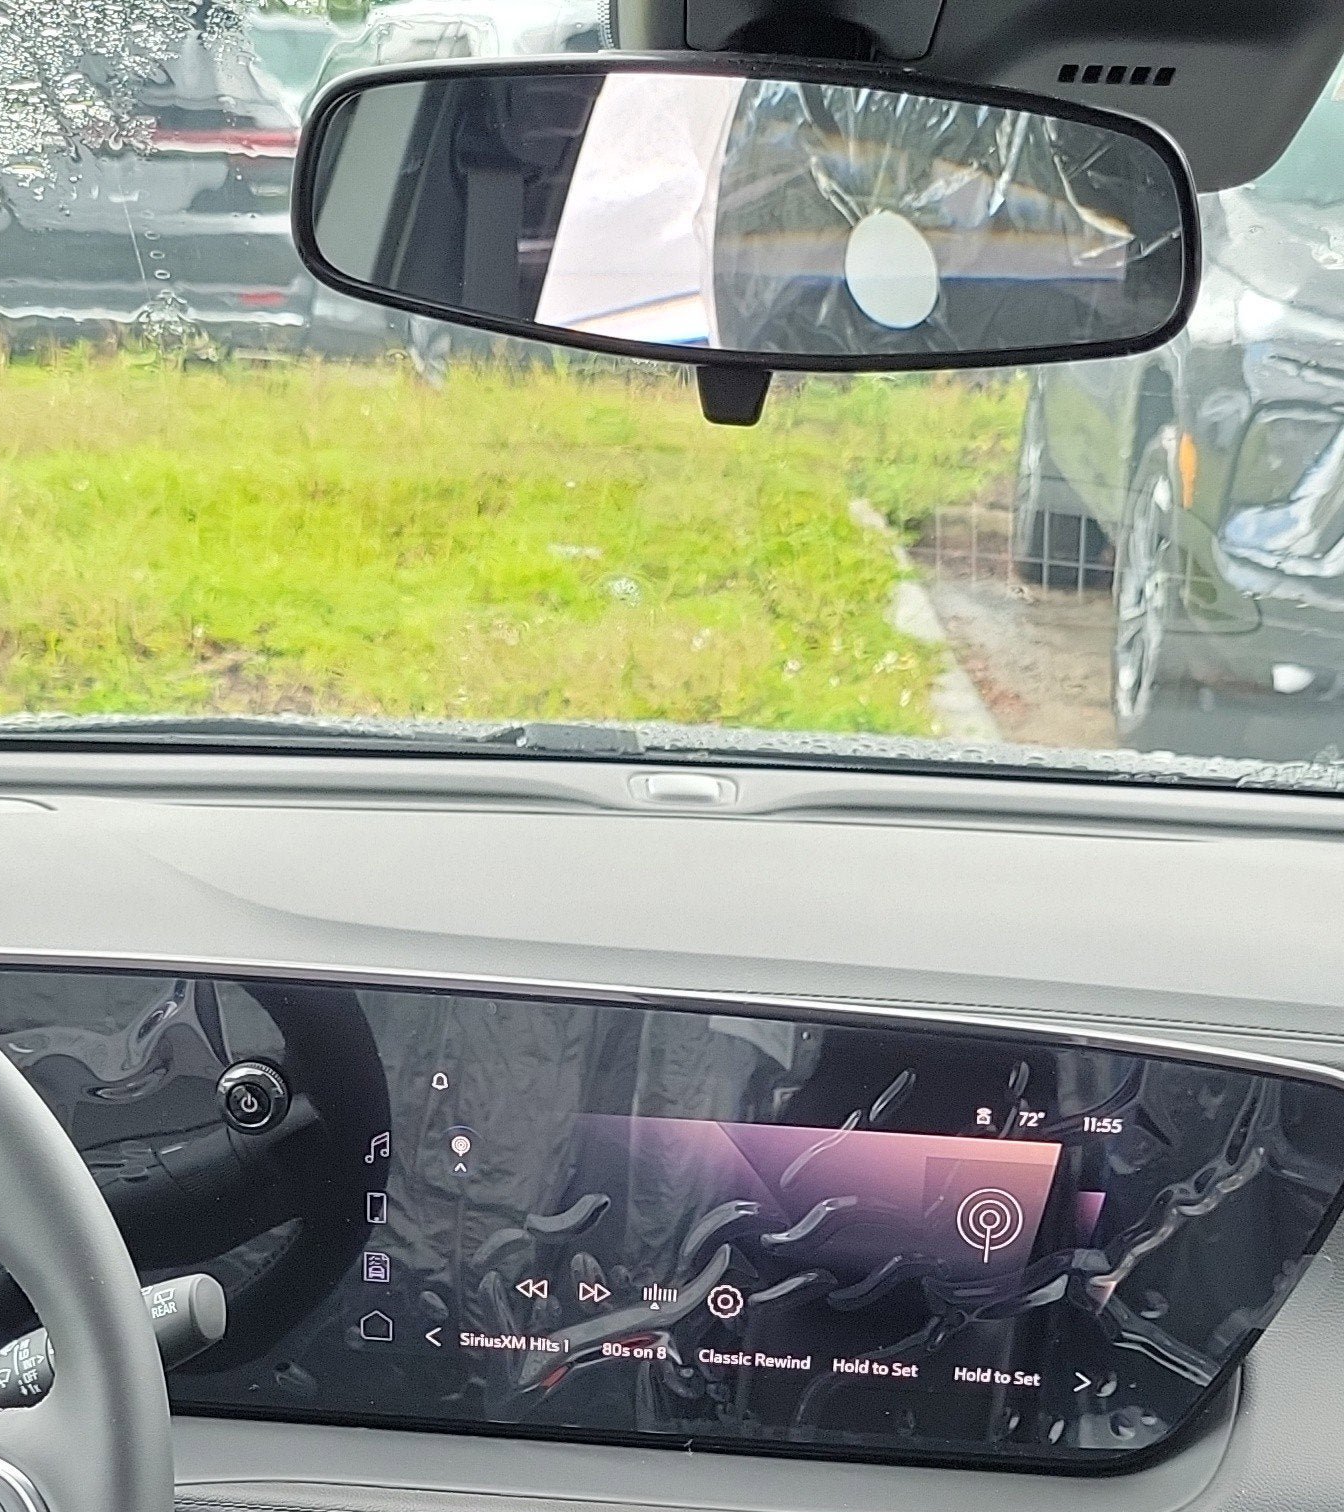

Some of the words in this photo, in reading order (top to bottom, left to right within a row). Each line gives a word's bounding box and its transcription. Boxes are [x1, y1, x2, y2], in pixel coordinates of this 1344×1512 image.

[1019, 1111, 1046, 1127] 72°
[1083, 1116, 1123, 1134] 11:55
[151, 1301, 177, 1319] REAR
[459, 1332, 527, 1350] SiriusXM
[530, 1335, 559, 1352] Hits
[563, 1339, 570, 1353] 1
[601, 1342, 631, 1357] 80s
[633, 1347, 653, 1359] on
[656, 1345, 667, 1359] 8
[698, 1349, 752, 1367] Classic
[755, 1352, 811, 1370] Rewind
[832, 1358, 870, 1375] Hold
[872, 1361, 889, 1376] to
[891, 1362, 919, 1378] Set
[22, 1368, 38, 1384] OFF
[954, 1366, 992, 1383] Hold
[994, 1370, 1011, 1385] to
[1013, 1371, 1041, 1387] Set
